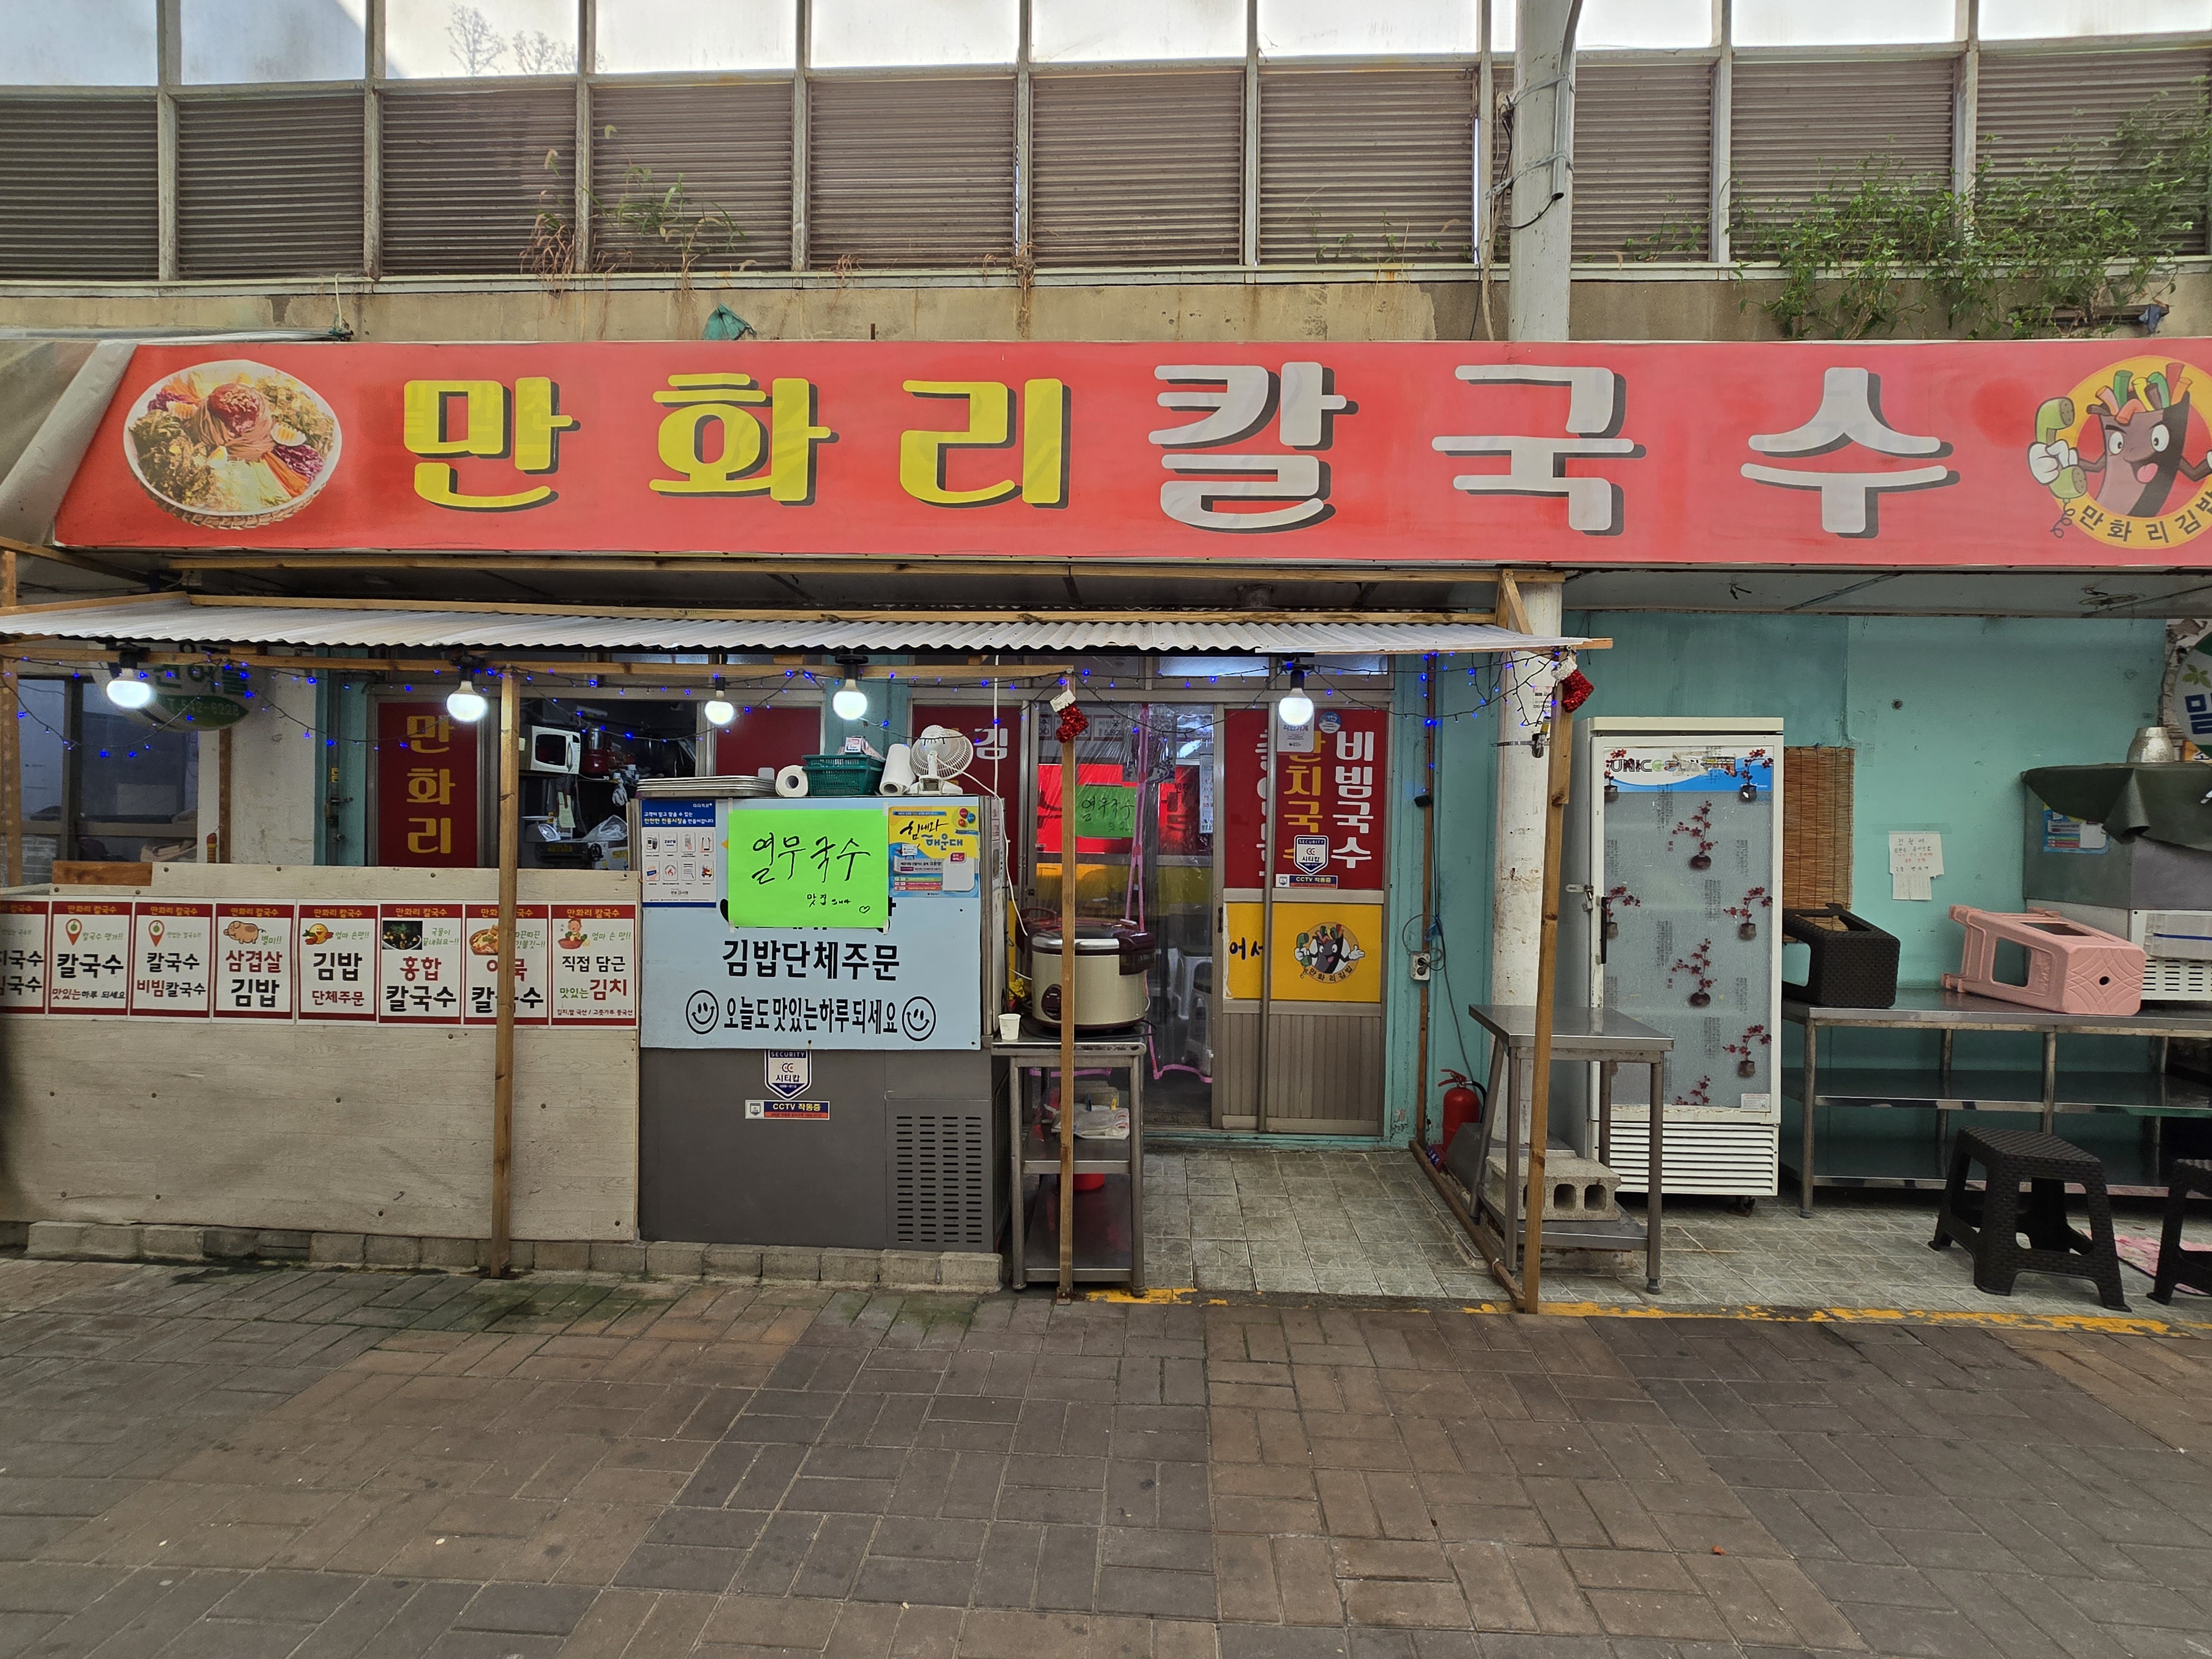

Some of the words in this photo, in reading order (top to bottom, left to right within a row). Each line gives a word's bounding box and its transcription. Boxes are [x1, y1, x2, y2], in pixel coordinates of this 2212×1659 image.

[404, 373, 1070, 511] 만화리
[1147, 362, 1961, 539] 칼국수
[406, 714, 456, 854] 만화리
[1331, 731, 1375, 869] 비빔국수
[921, 833, 963, 851] 해운대
[751, 832, 871, 885] 열무국수
[67, 905, 91, 914] 만화리
[93, 905, 117, 915] 칼국수
[150, 906, 174, 915] 만화리
[175, 906, 198, 916] 칼국수
[230, 907, 254, 916] 만화리
[255, 907, 279, 917] 칼국수
[314, 909, 337, 918] 만화리
[339, 909, 363, 918] 칼국수
[395, 908, 420, 917] 만화리
[422, 908, 447, 917] 칼국수
[567, 908, 592, 917] 만화리
[594, 908, 620, 918] 칼국수
[431, 927, 451, 936] 국물이
[591, 931, 606, 940] 엄마
[57, 953, 124, 979] 칼국수
[147, 952, 200, 973] 칼국수
[225, 950, 283, 973] 삼겹살
[313, 952, 363, 982] 김밥
[399, 956, 442, 982] 홍합
[561, 955, 590, 973] 직접
[596, 956, 626, 973] 담근
[722, 939, 900, 982] 김밥단체주문
[101, 990, 126, 999] 되세요
[231, 978, 280, 1008] 김밥
[311, 990, 365, 1007] 단체주문
[385, 985, 457, 1013] 칼국수
[559, 987, 589, 1000] 맛있는
[589, 978, 627, 1001] 김치
[471, 987, 544, 1014] 칼수
[775, 1074, 800, 1083] 시티캅
[798, 1103, 821, 1112] 작동중
